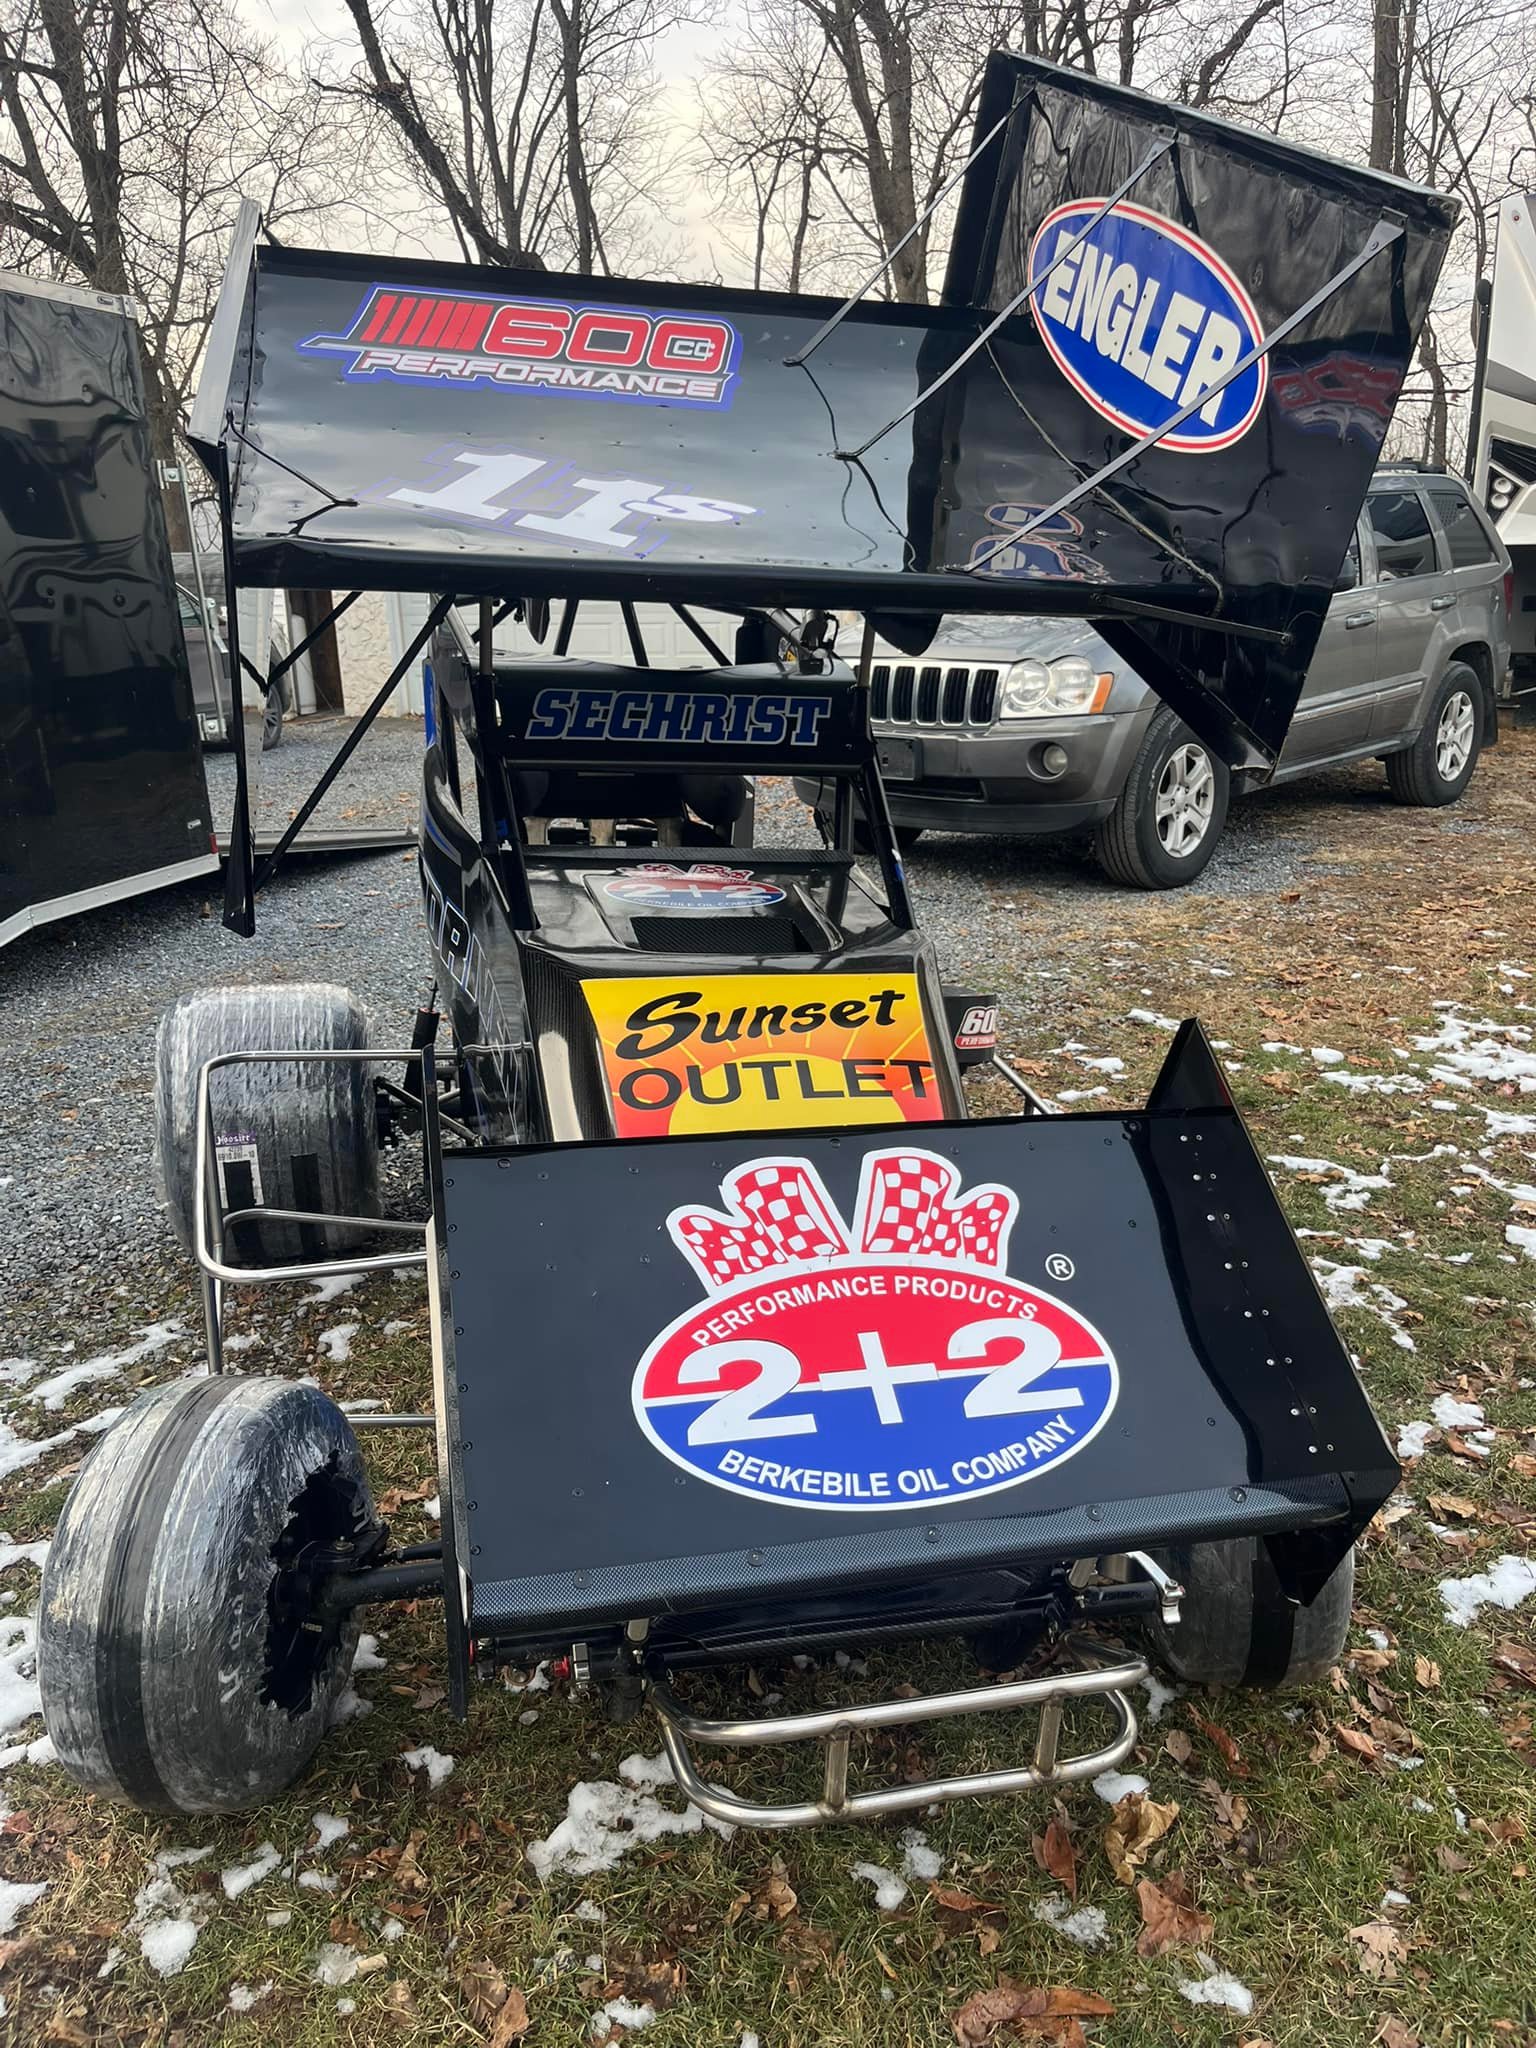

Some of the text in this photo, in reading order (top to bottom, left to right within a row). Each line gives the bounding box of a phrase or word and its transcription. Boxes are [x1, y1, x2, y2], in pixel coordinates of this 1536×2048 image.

[484, 304, 729, 374] 600
[1041, 229, 1242, 428] ENGLER
[360, 351, 718, 398] PERFORMANCE
[525, 688, 833, 747] SECHRIST
[619, 883, 772, 899] 2+2
[614, 989, 906, 1061] Sunset
[619, 1059, 934, 1111] OUTLET
[691, 1275, 1038, 1347] PERFORMANCE PRODUCTS
[677, 1317, 1085, 1446] 2+2
[717, 1414, 1076, 1497] BERKEBILE OIL COMPANY
